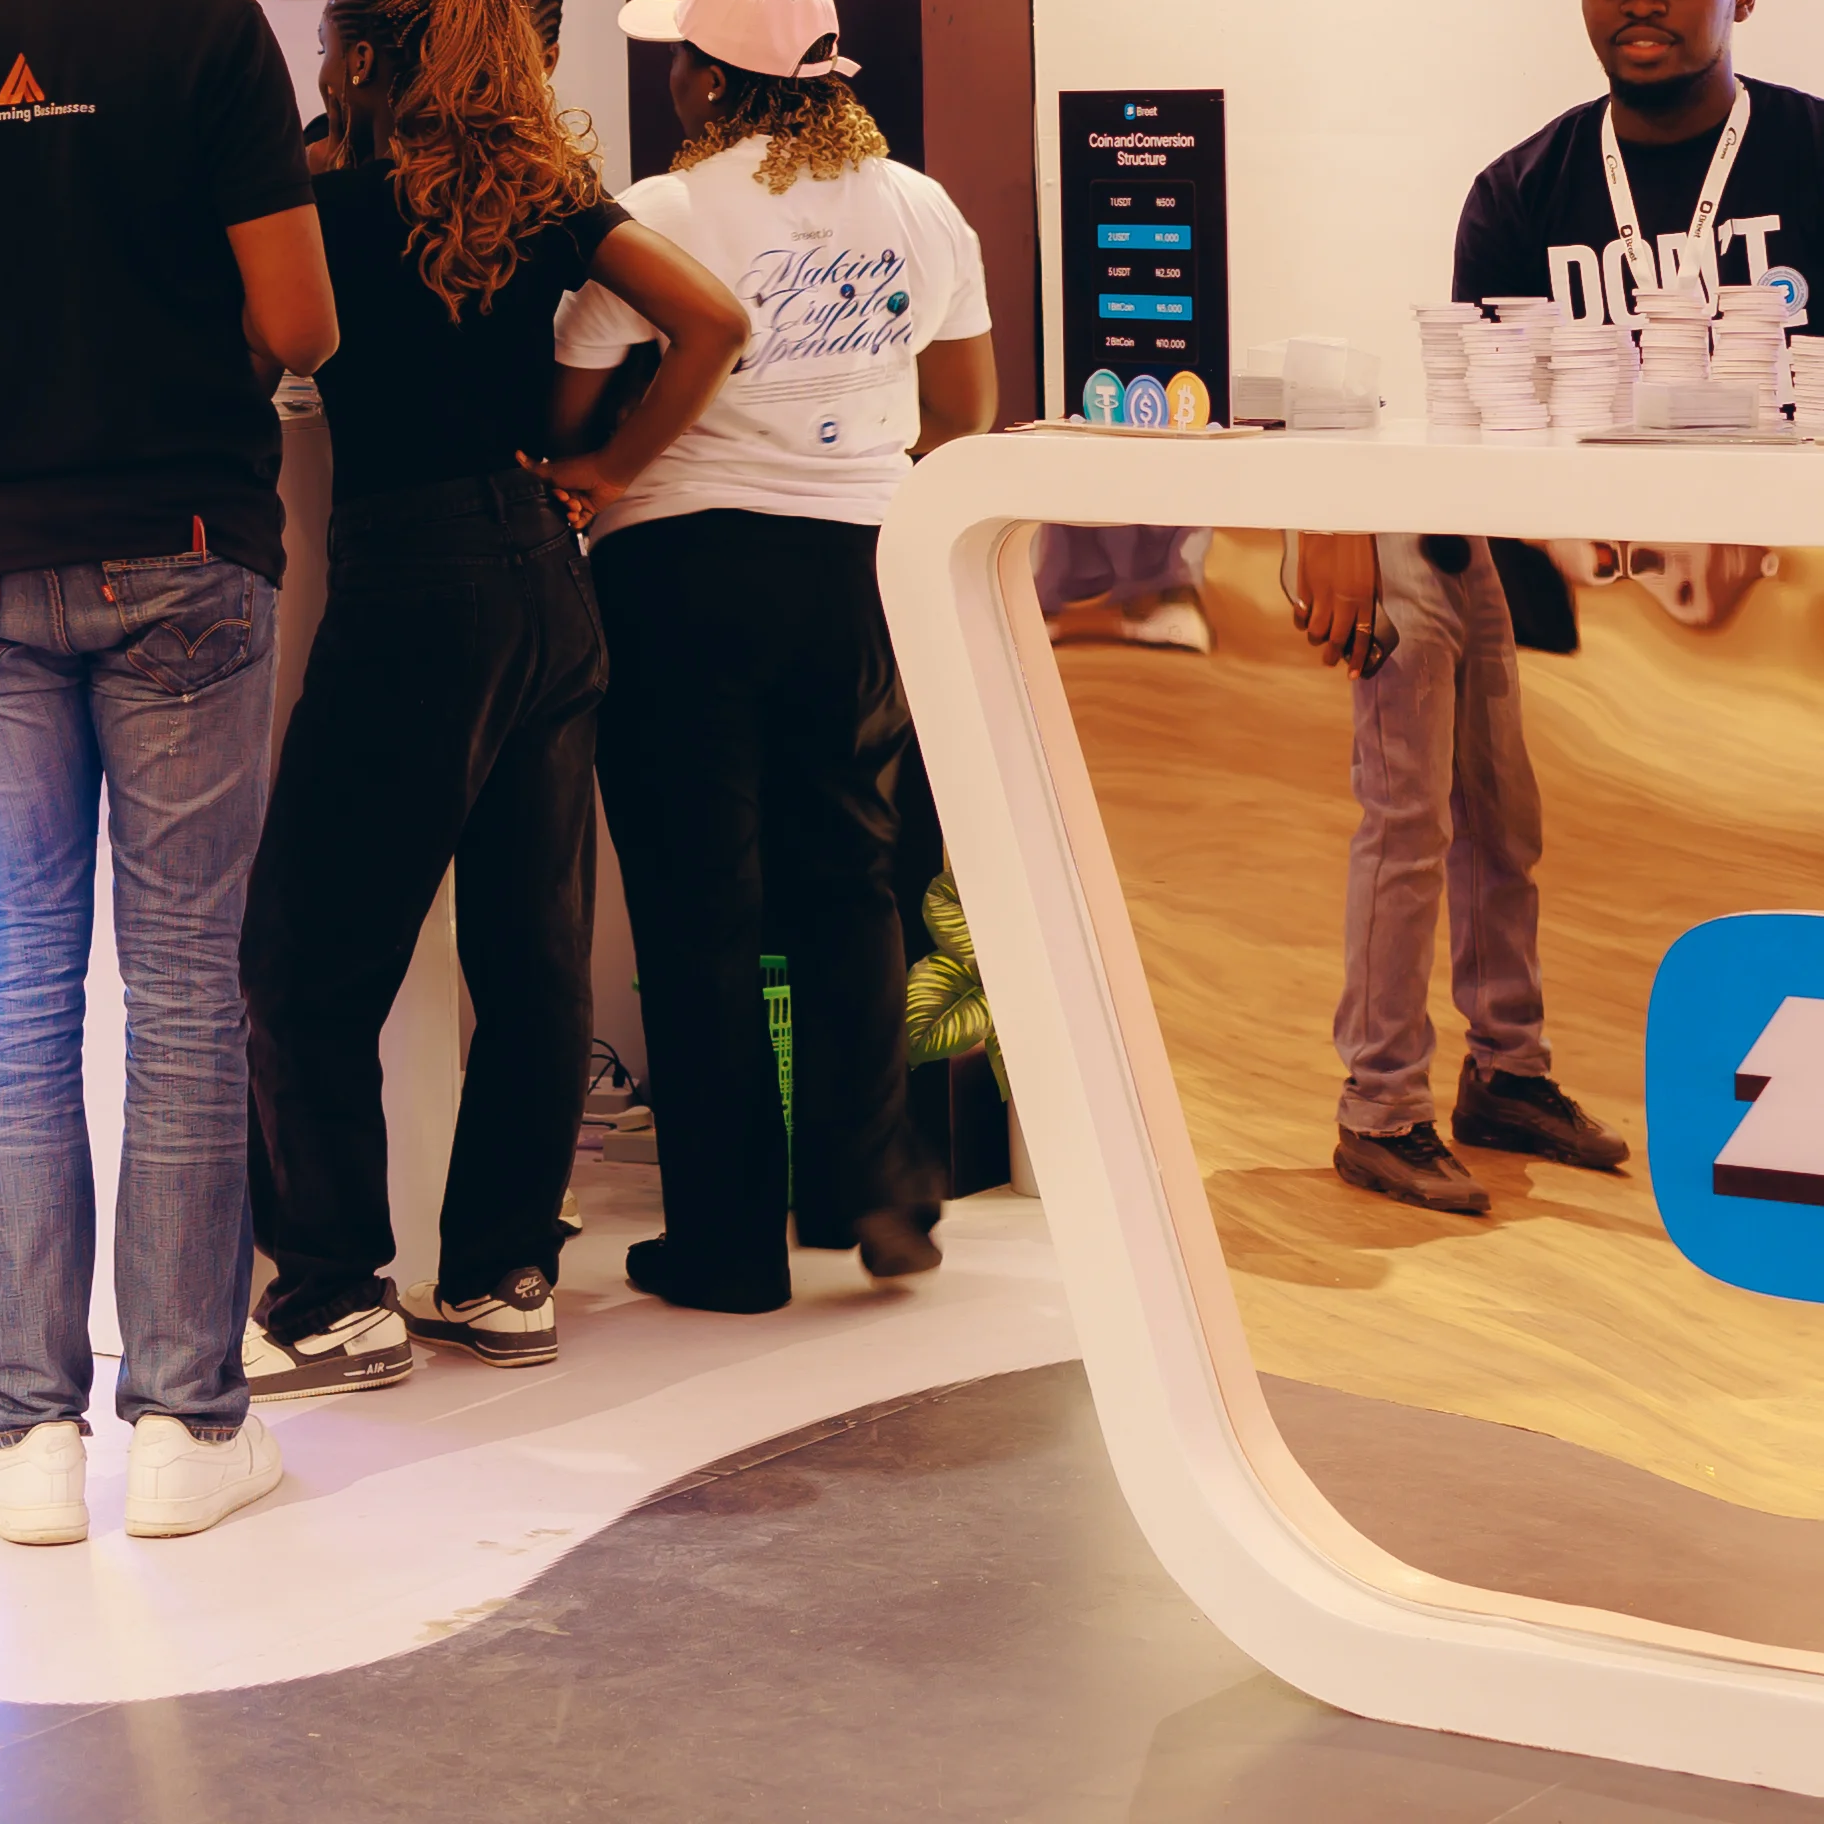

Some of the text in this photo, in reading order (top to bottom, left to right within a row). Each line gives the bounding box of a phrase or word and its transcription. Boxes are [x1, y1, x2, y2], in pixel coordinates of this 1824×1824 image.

[34, 102, 96, 117] Businesses
[1136, 106, 1158, 116] Breet
[1089, 132, 1195, 148] Coin and Conversion
[1117, 151, 1167, 166] Structure
[735, 245, 907, 300] Making
[366, 1362, 385, 1375] AIR
